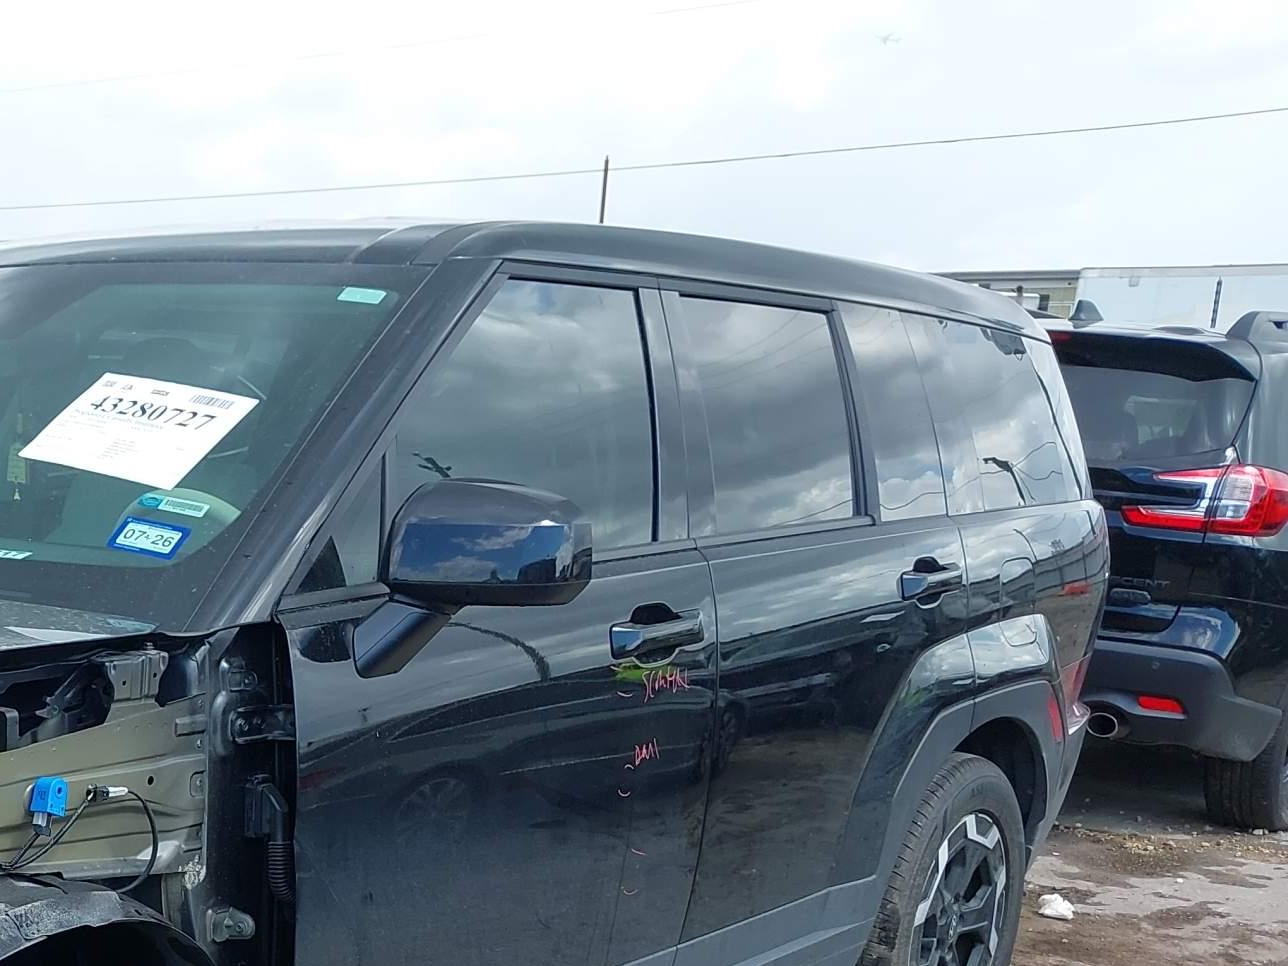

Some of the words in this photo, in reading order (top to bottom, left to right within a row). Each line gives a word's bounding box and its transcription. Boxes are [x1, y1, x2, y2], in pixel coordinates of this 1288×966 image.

[91, 394, 216, 430] 43280727
[123, 528, 147, 541] 07
[150, 534, 175, 548] 26
